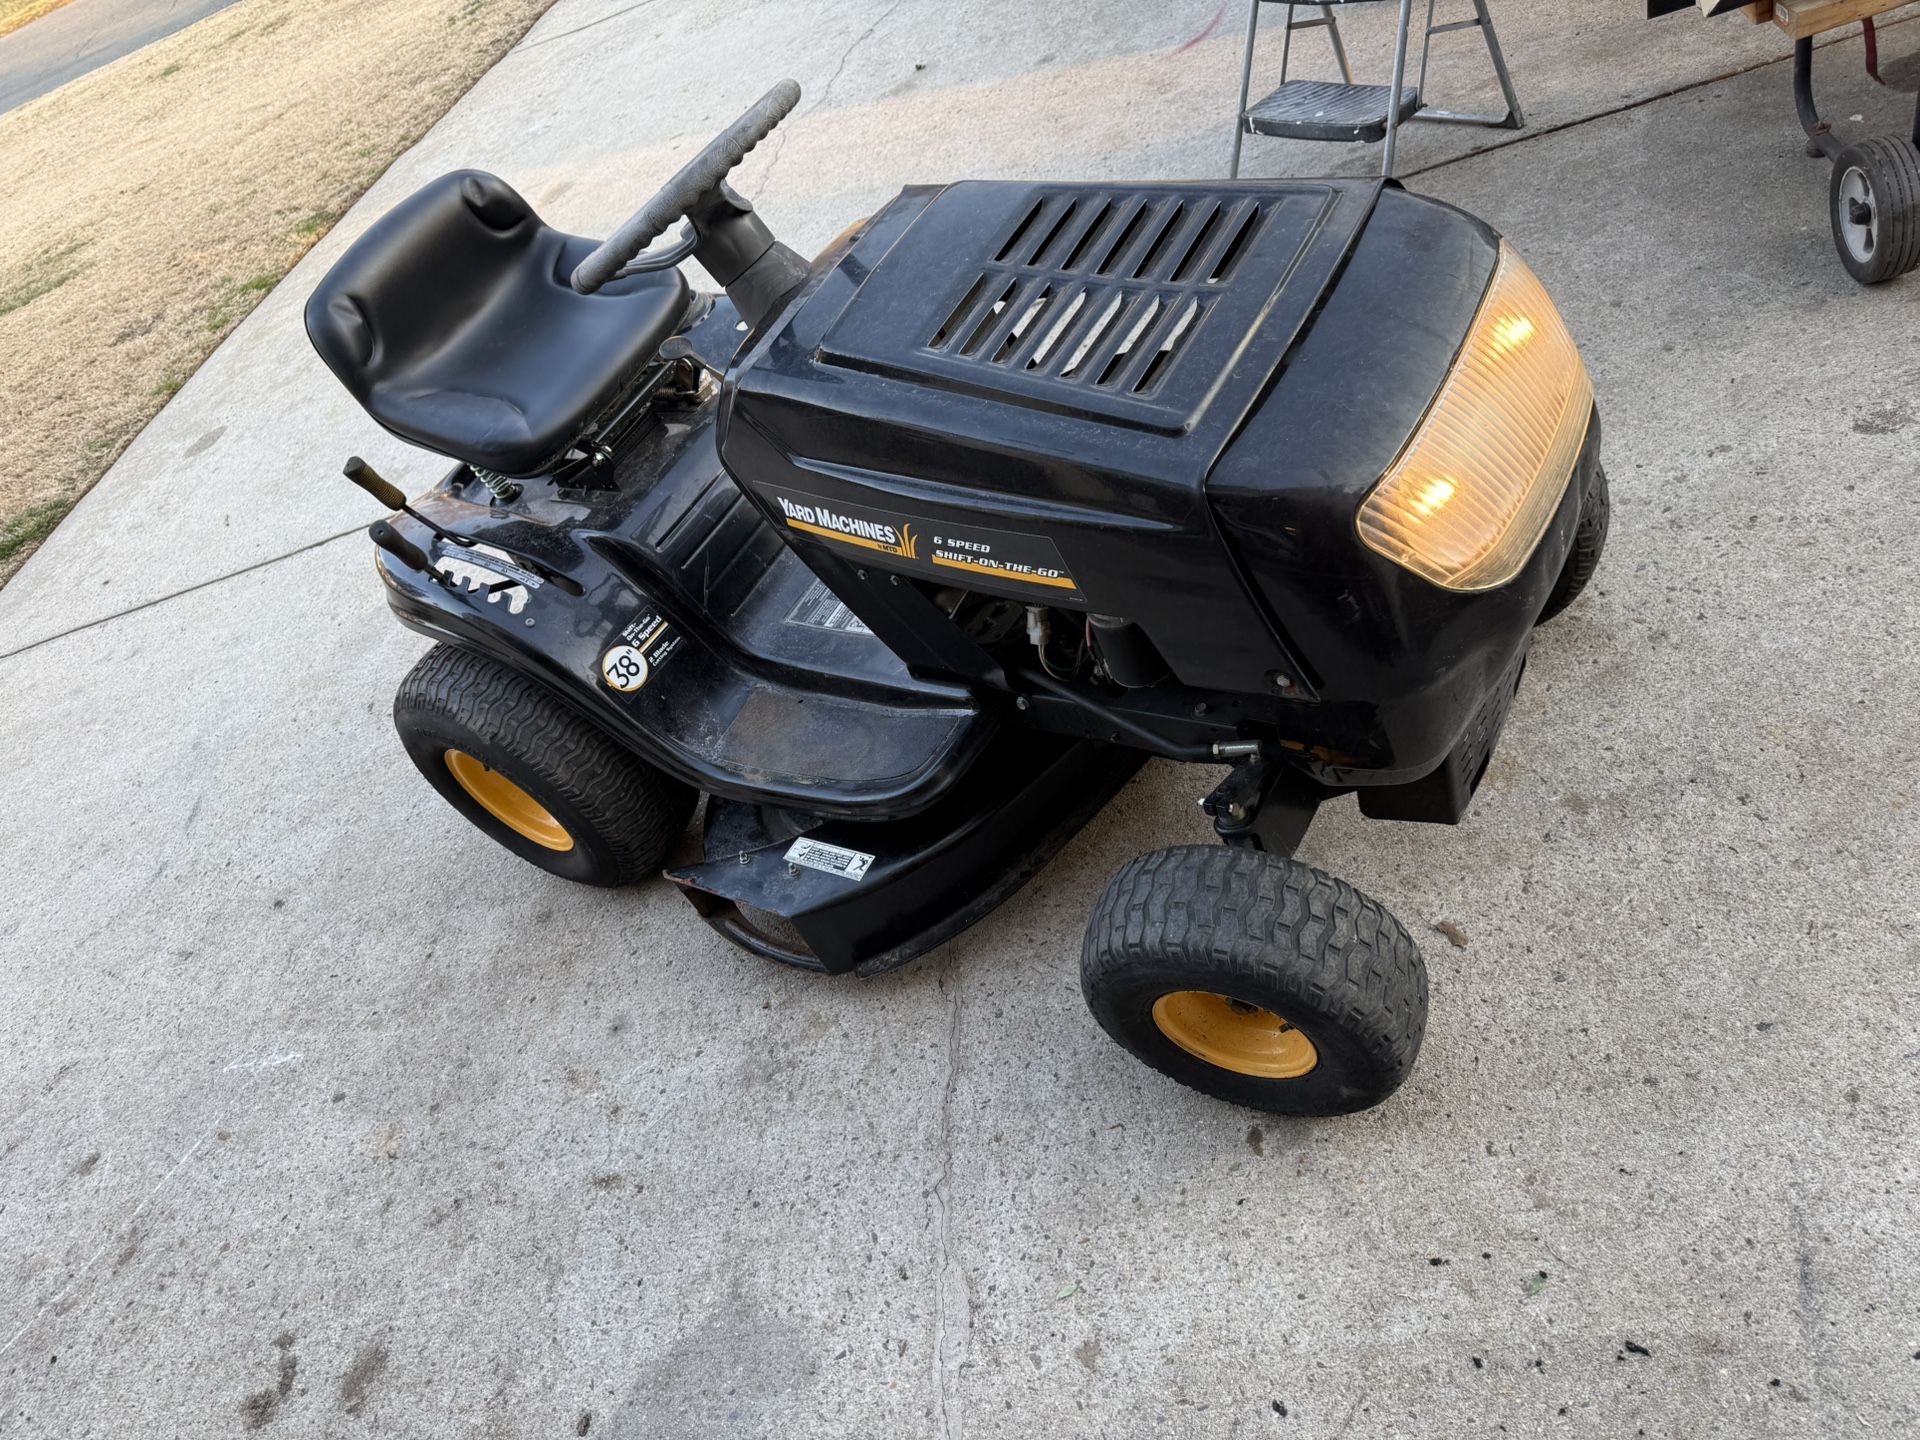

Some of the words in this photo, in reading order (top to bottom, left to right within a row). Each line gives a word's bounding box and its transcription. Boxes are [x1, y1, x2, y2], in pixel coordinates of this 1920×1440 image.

[777, 496, 815, 523] YARD
[815, 506, 896, 544] MACHINES
[933, 536, 943, 545] 6
[947, 538, 991, 553] SPEED
[631, 639, 640, 648] 6
[638, 615, 662, 641] Speed
[653, 641, 670, 657] Blade
[606, 648, 640, 689] 38"
